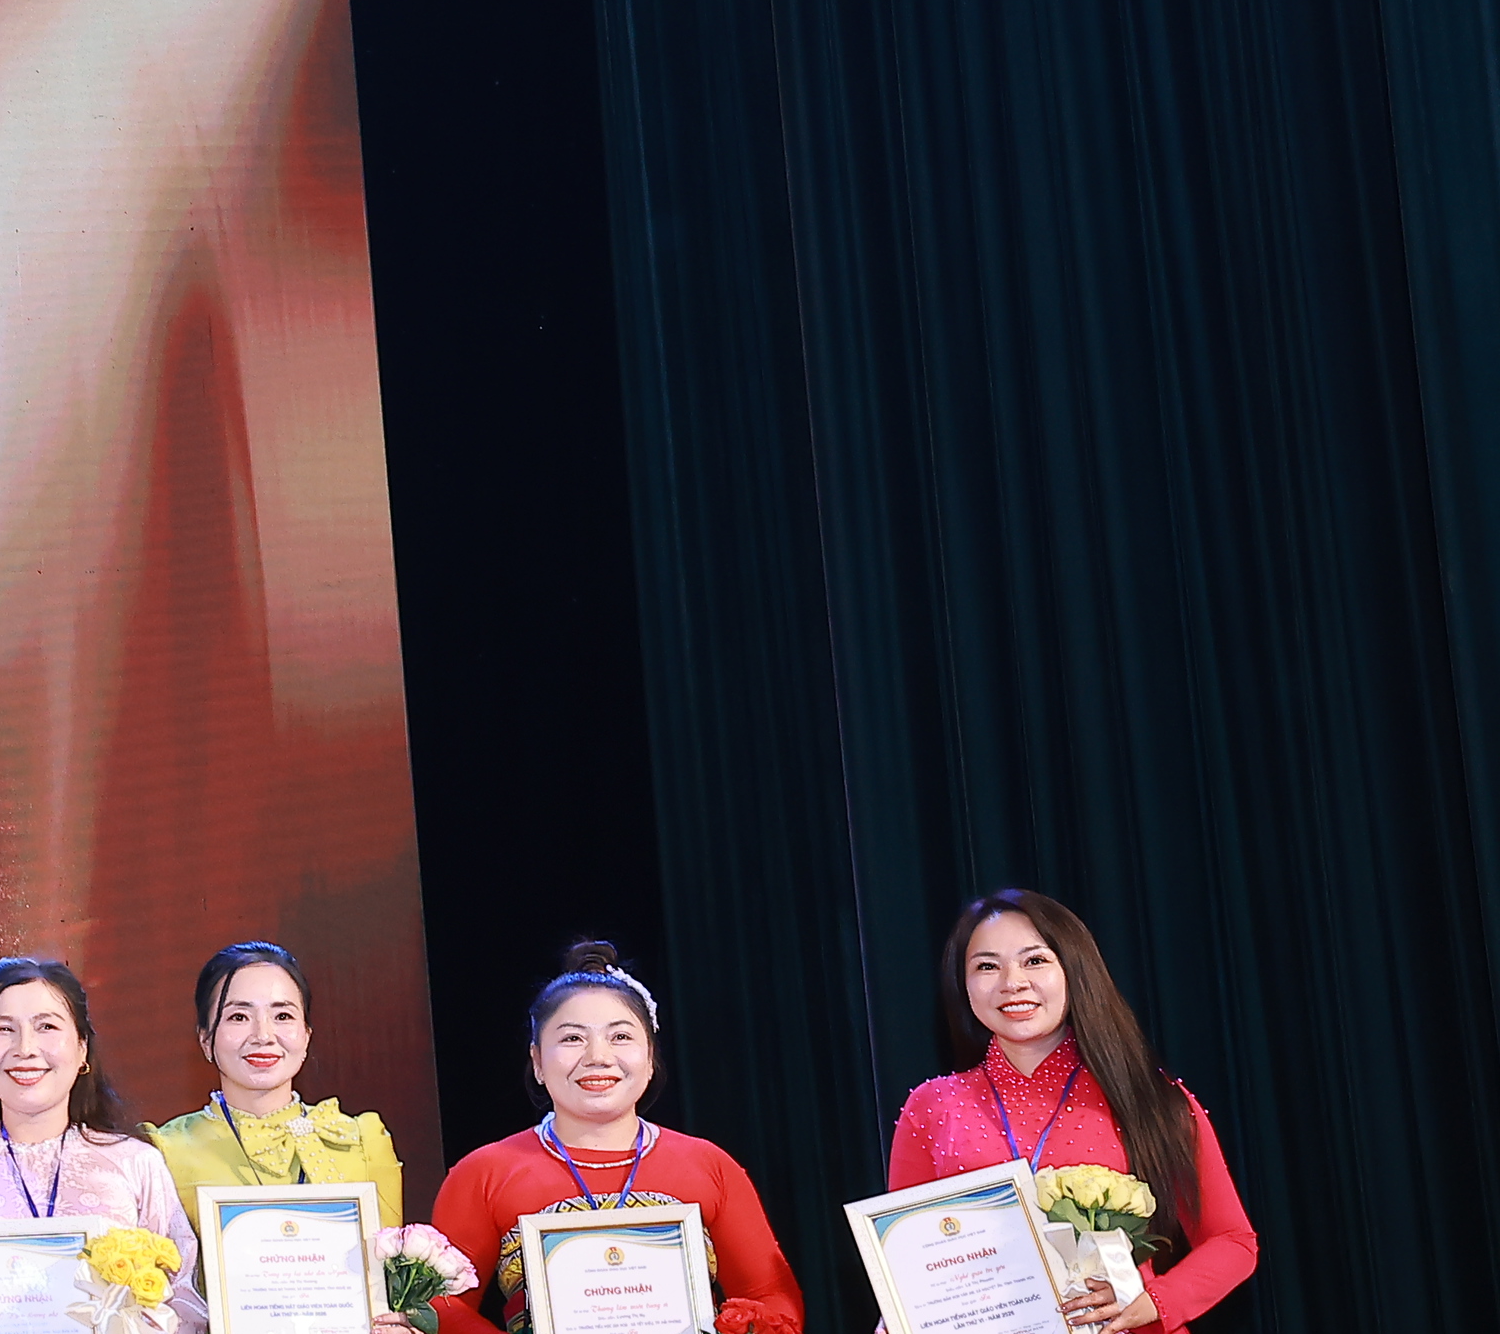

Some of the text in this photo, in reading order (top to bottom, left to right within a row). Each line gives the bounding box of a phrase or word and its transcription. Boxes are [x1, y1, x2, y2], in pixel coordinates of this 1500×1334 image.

[259, 1252, 326, 1264] CHỨNG NHẬN
[925, 1246, 998, 1272] CHỨNG NHẬN
[584, 1283, 653, 1297] CHỨNG NHẬN
